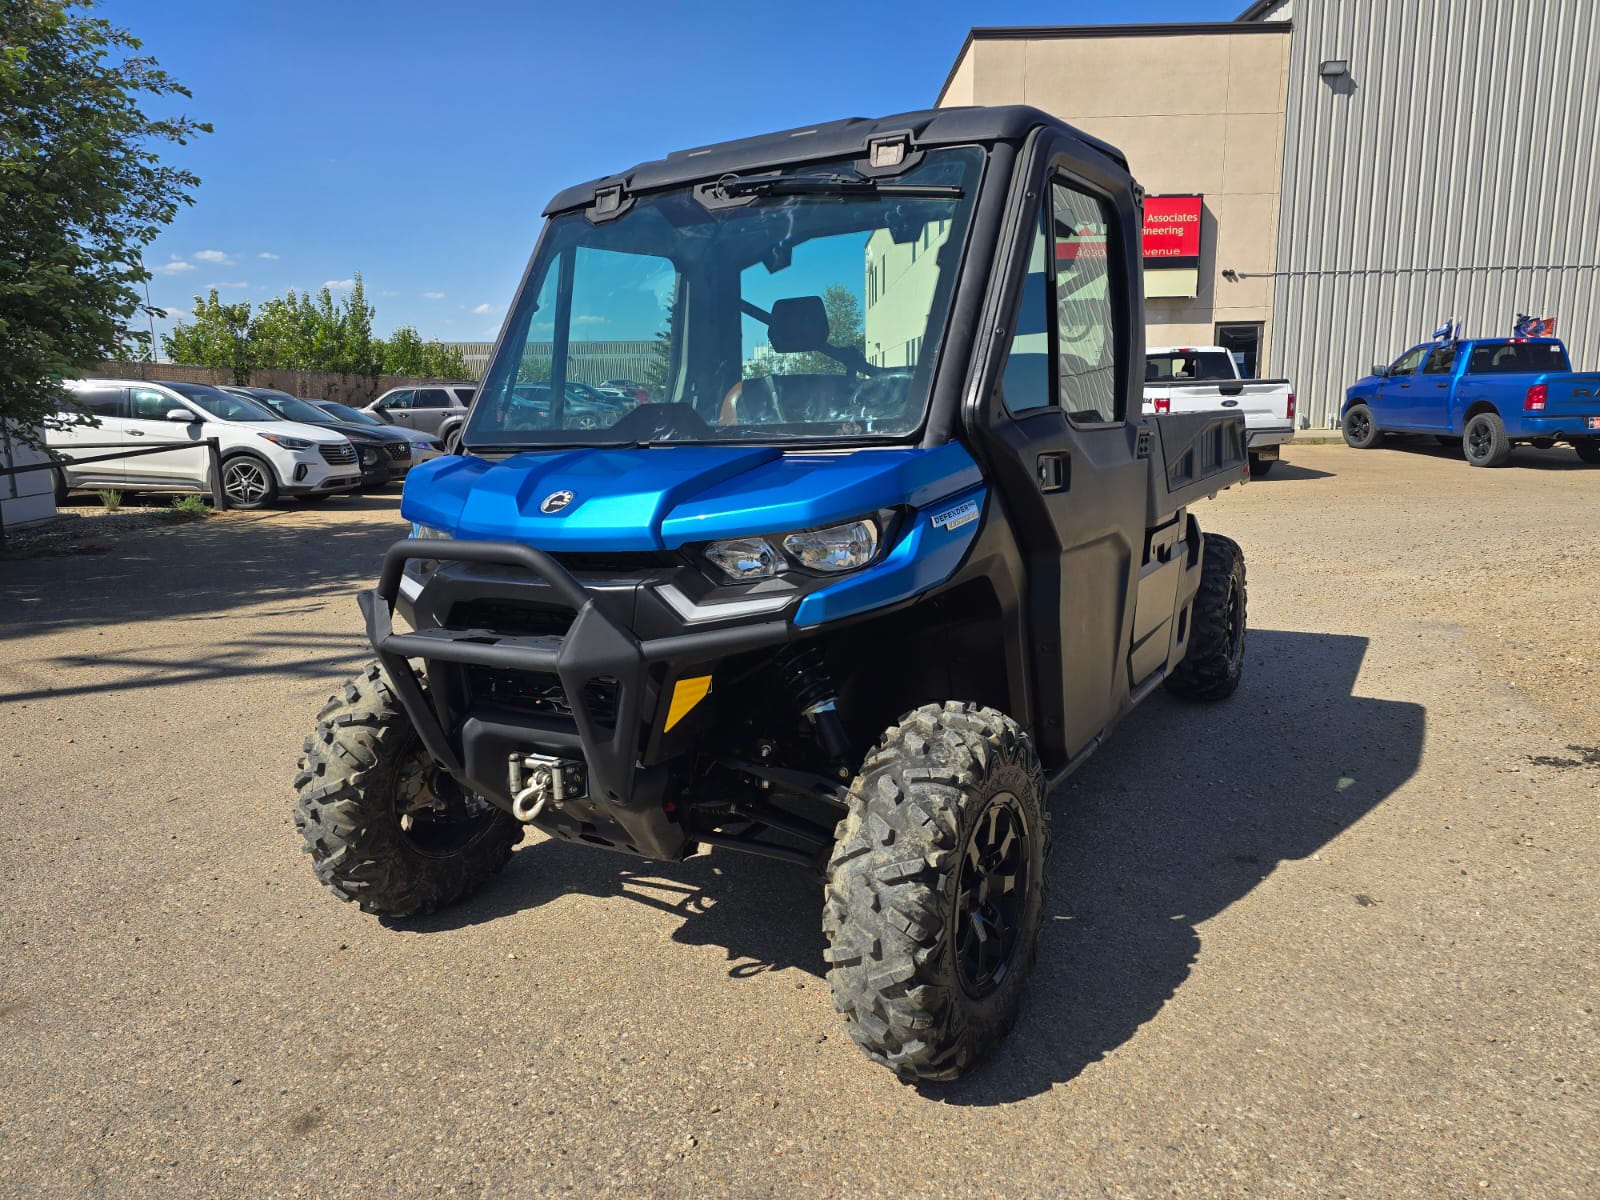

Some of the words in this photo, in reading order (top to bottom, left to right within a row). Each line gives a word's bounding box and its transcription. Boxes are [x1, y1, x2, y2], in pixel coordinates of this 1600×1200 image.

[1147, 213, 1198, 222] Associates
[1142, 226, 1184, 237] ineering
[1143, 248, 1181, 256] venue
[934, 504, 969, 524] DEFENDER
